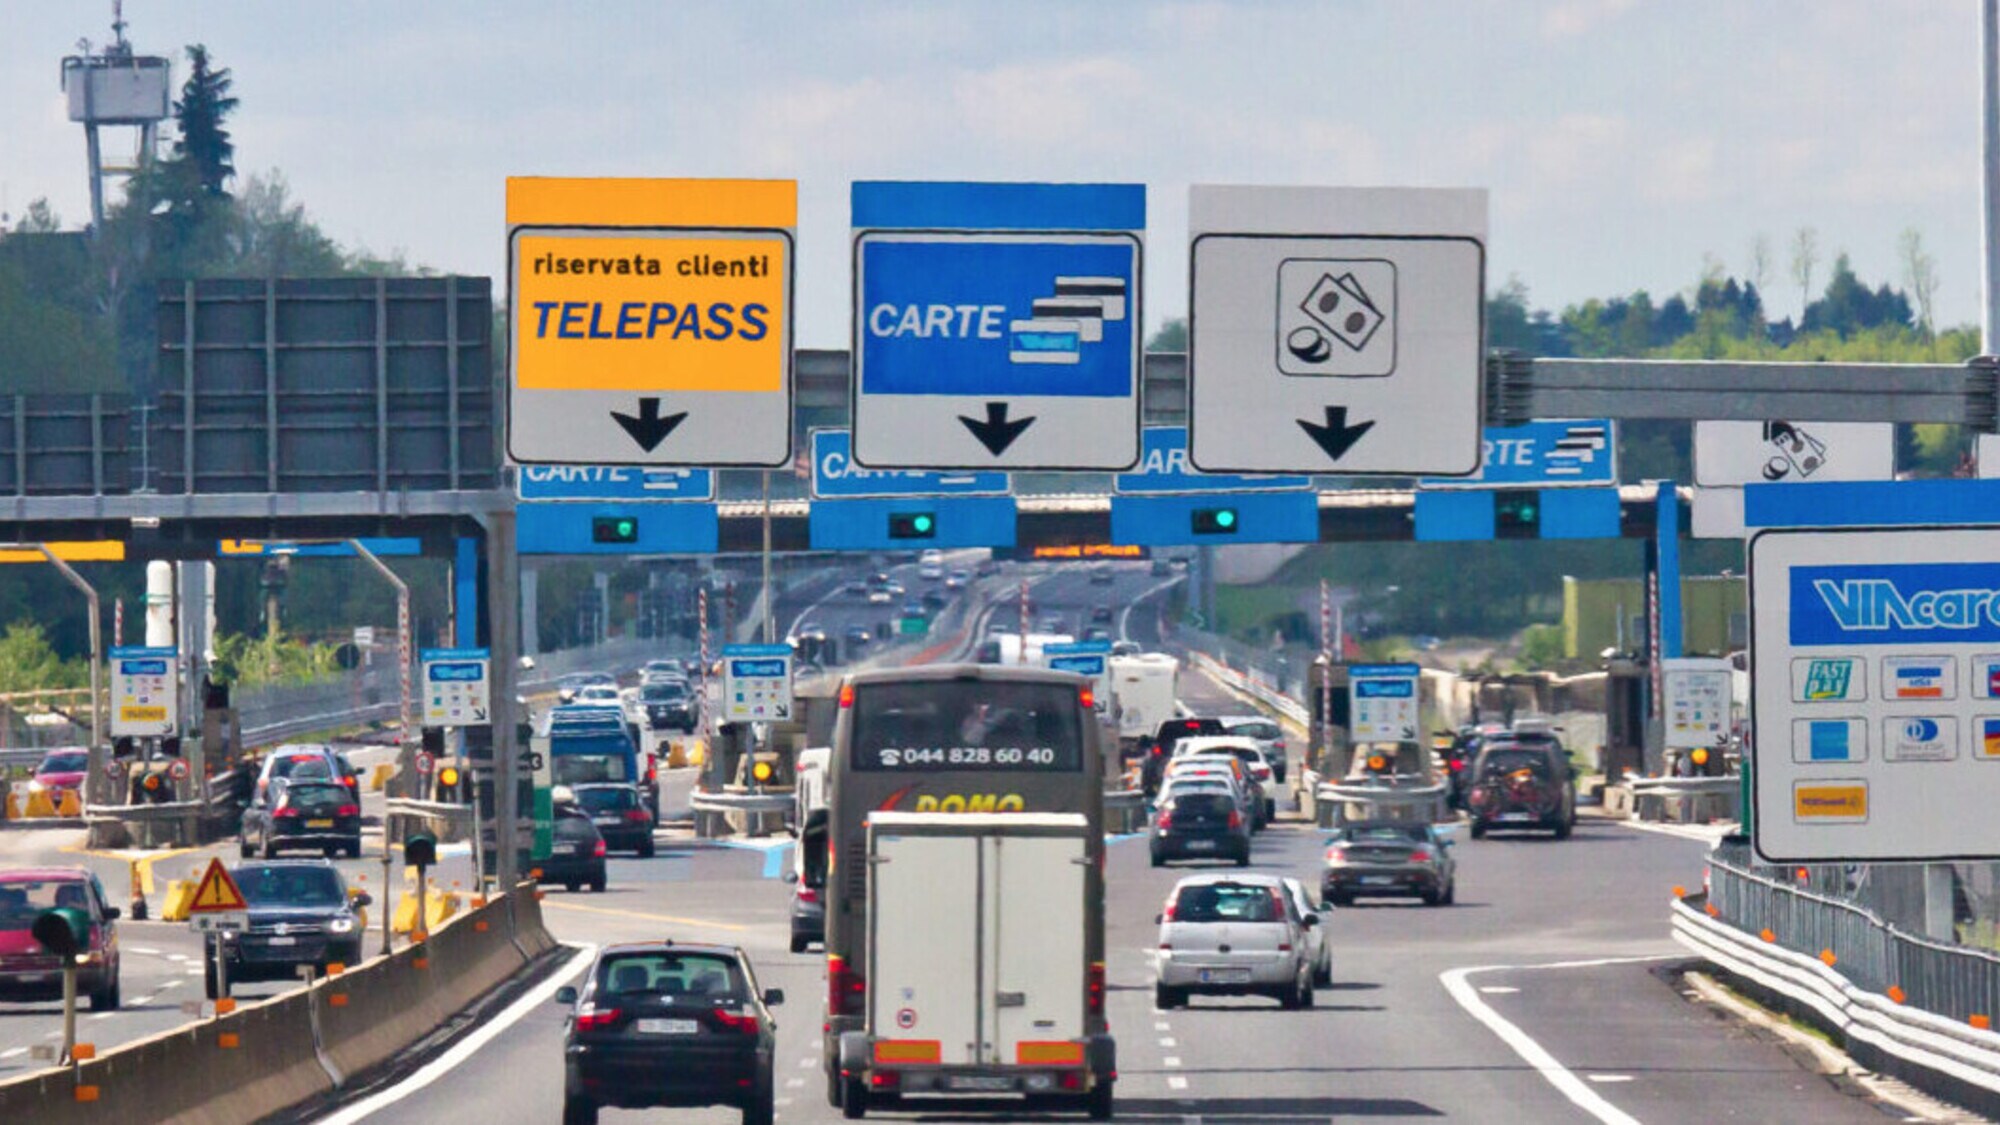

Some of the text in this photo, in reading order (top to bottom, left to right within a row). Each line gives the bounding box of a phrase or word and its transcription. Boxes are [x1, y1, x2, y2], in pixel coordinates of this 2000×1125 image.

[534, 253, 769, 277] riservata clienti
[533, 302, 769, 341] TELEPASS
[869, 303, 1006, 339] CARTE
[903, 747, 1055, 764] 044 828 60 40
